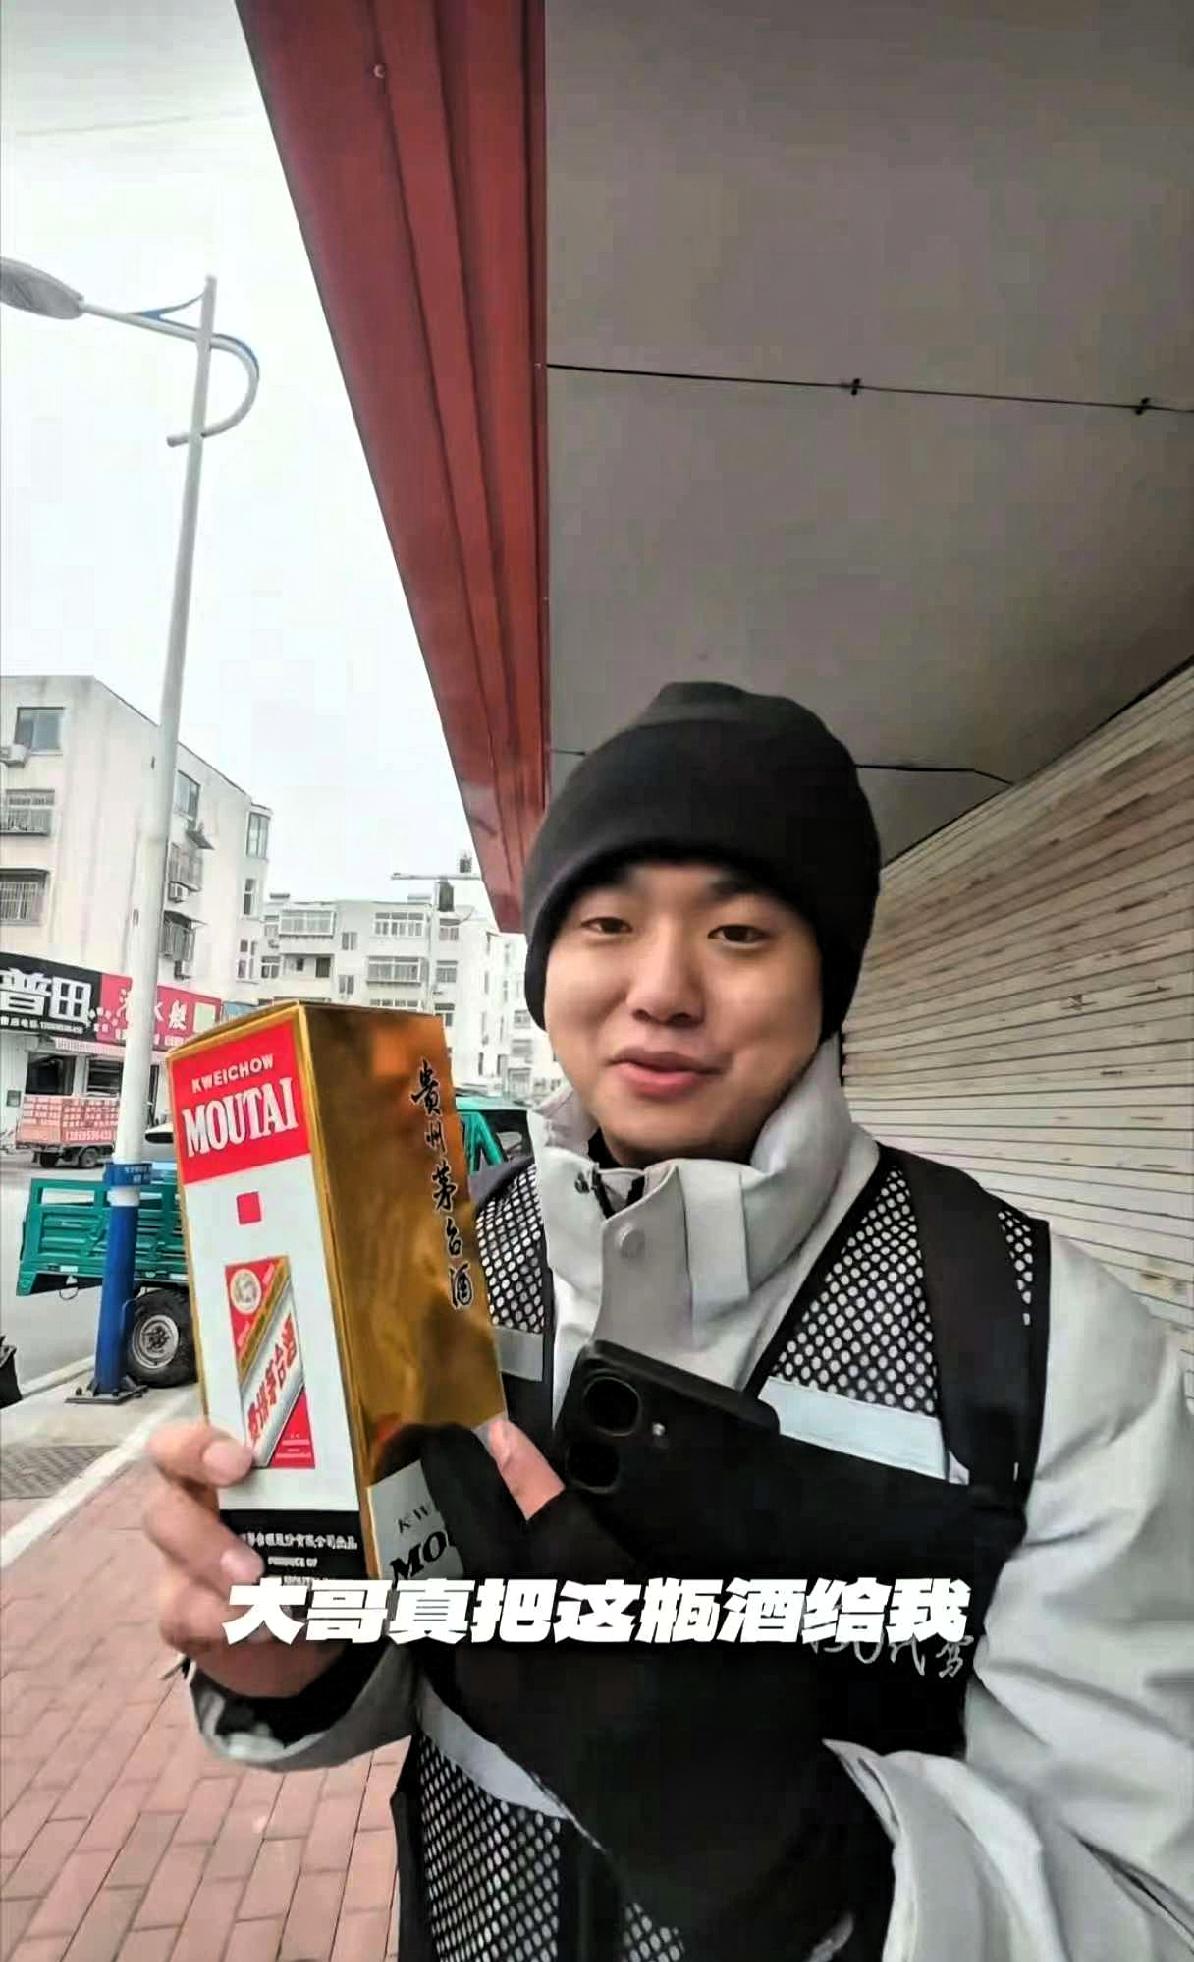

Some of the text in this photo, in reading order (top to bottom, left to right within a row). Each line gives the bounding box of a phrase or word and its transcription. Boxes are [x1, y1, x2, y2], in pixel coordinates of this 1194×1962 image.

[0, 967, 91, 1023] 普田
[191, 1054, 273, 1093] KWEICHOW
[182, 1077, 299, 1157] MOUTAI
